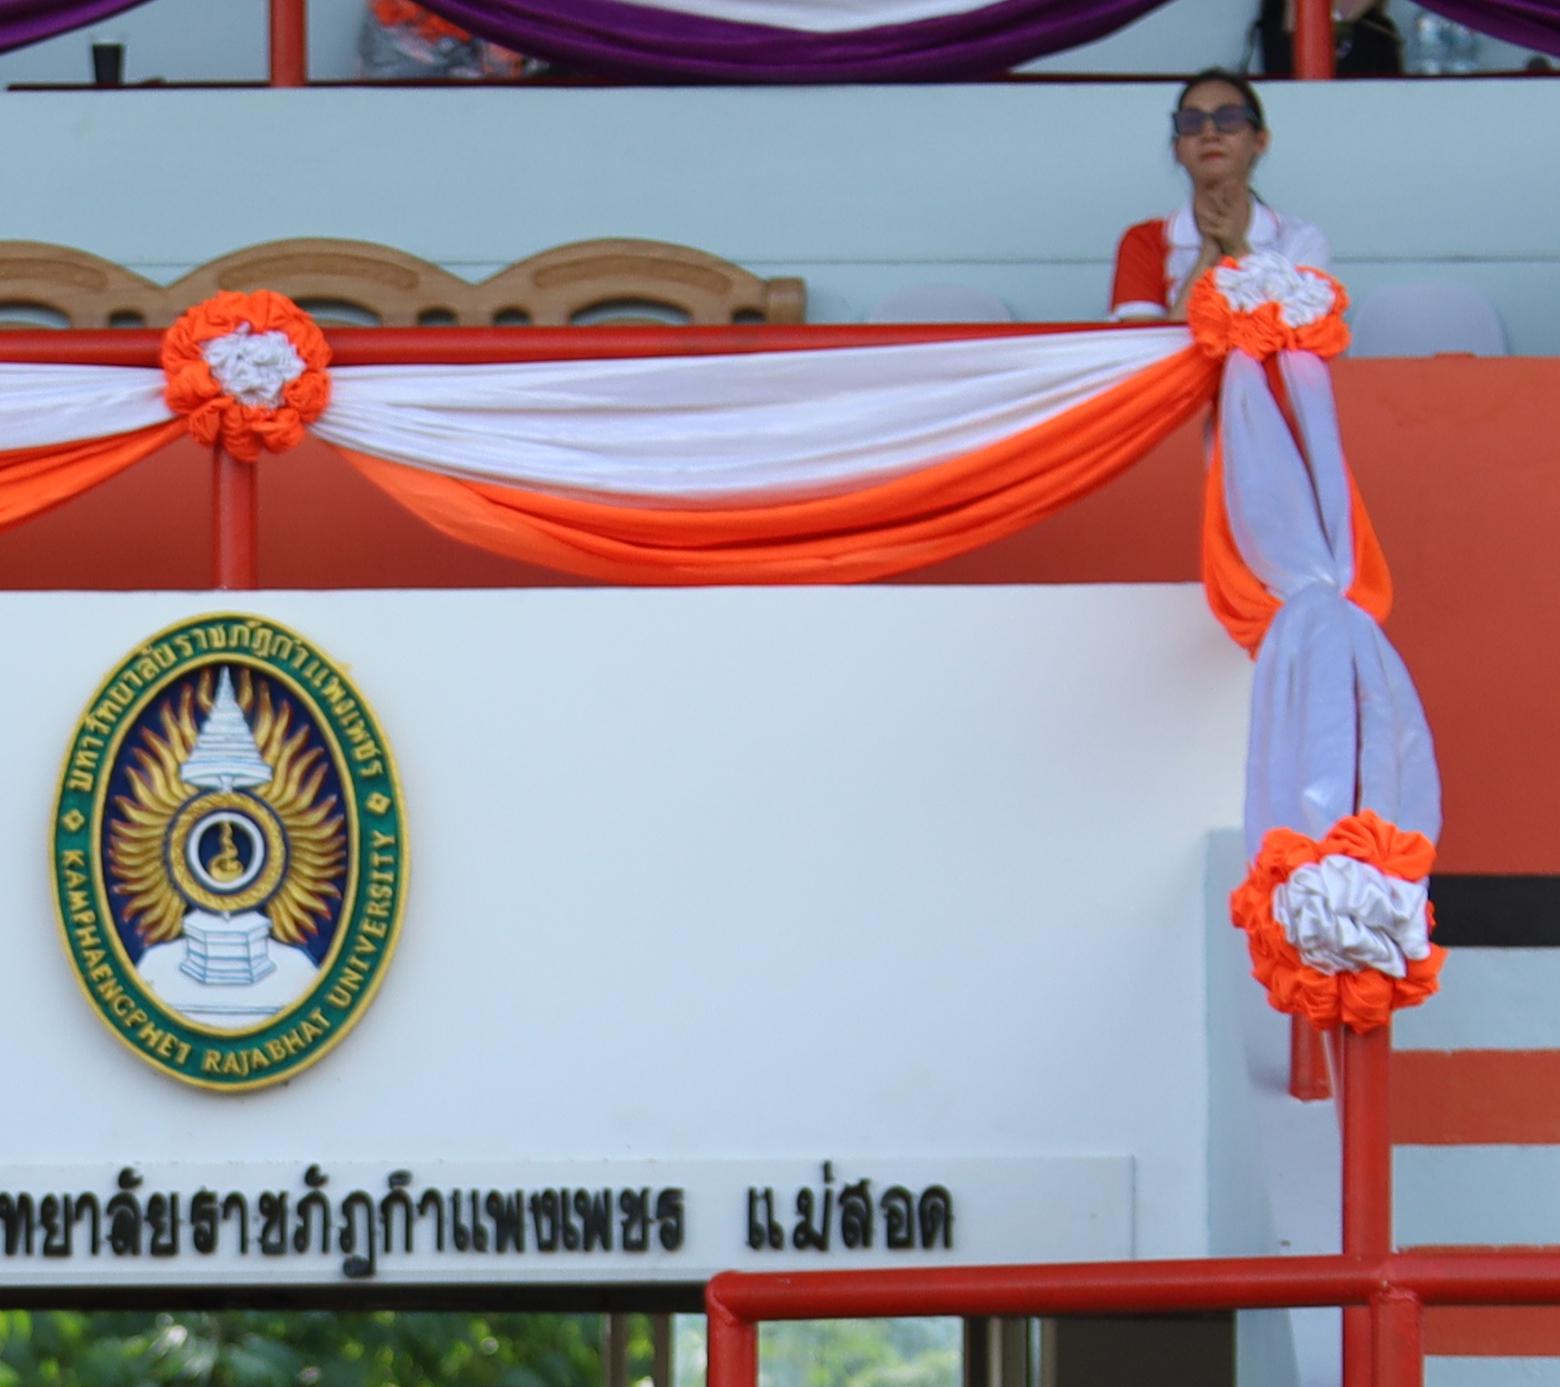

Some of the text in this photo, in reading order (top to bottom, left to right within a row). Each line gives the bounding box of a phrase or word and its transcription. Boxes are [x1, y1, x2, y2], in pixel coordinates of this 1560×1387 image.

[202, 1008, 332, 1079] RAJABHAT
[326, 831, 397, 1008] UNIVERSITY
[745, 1161, 955, 1252] แม่สอด
